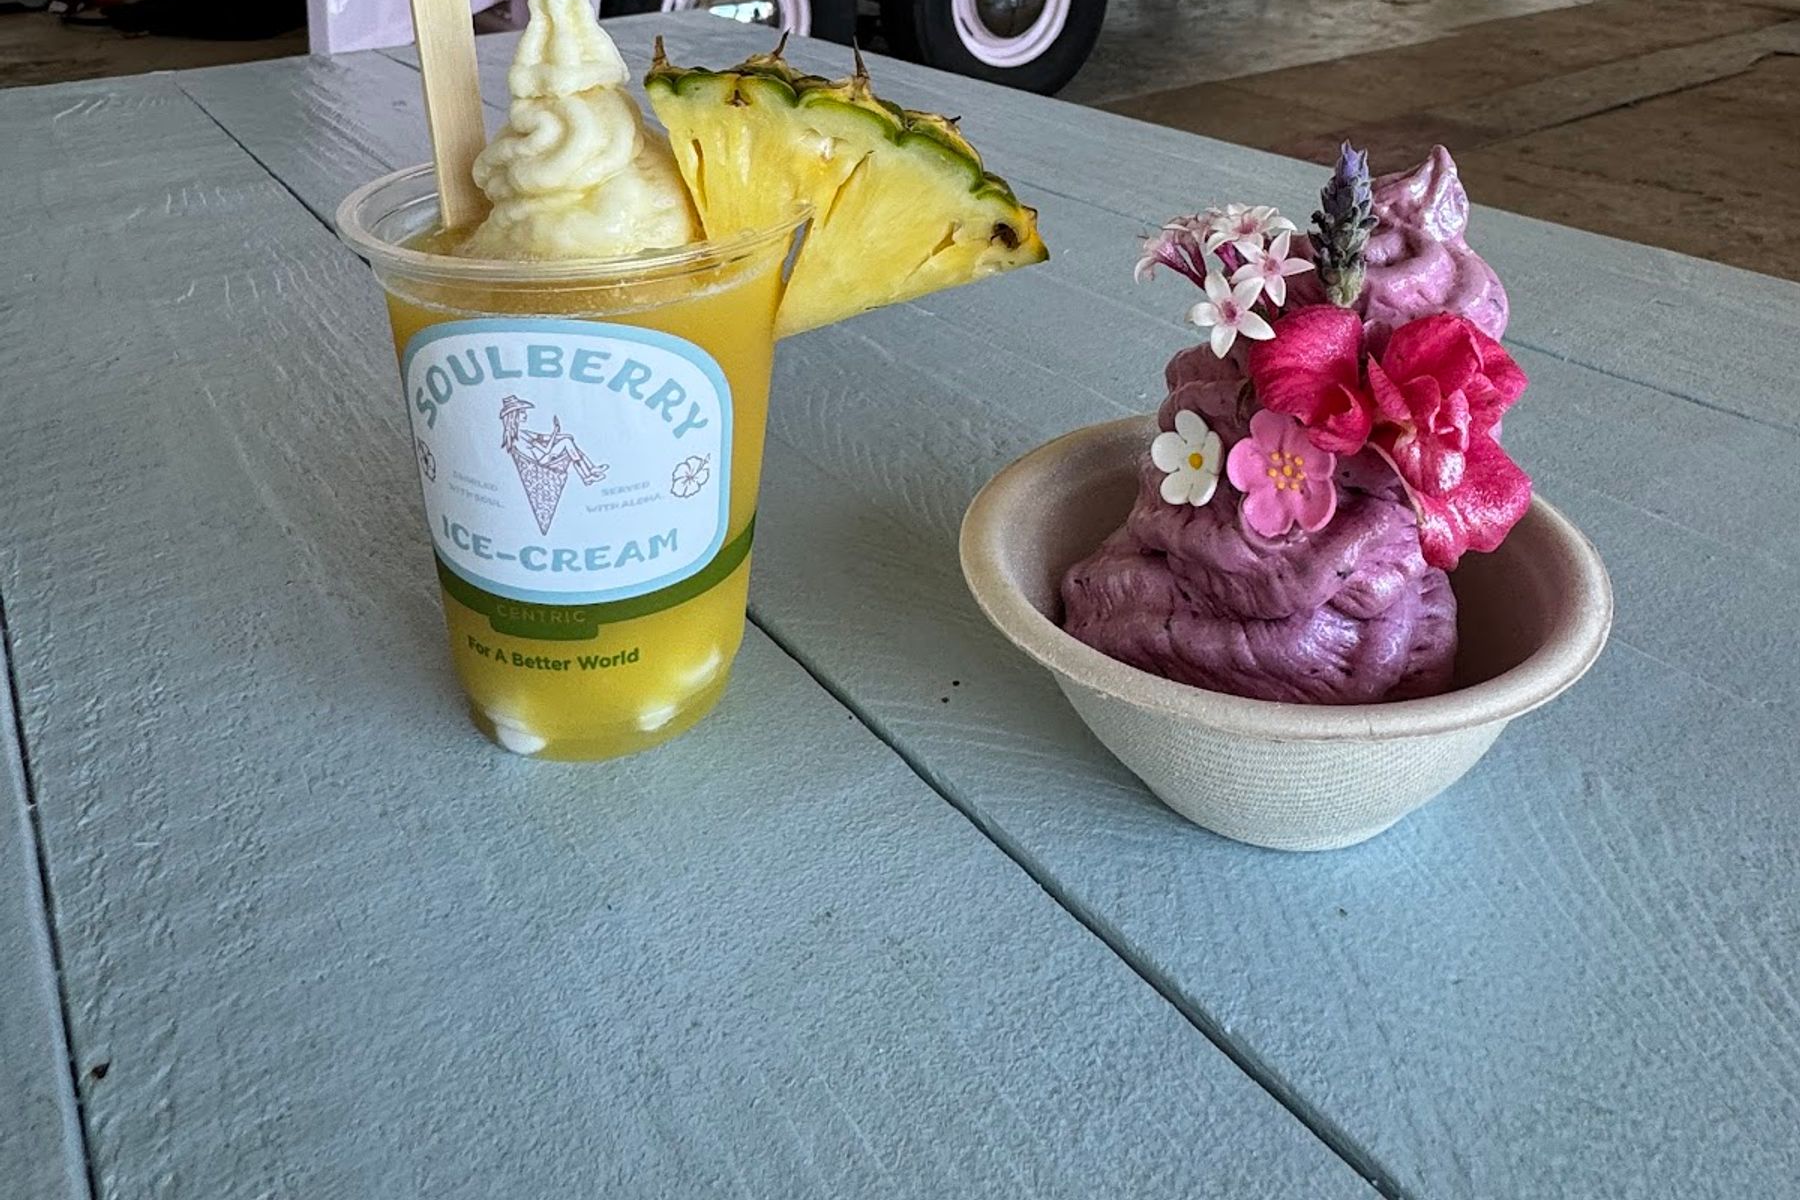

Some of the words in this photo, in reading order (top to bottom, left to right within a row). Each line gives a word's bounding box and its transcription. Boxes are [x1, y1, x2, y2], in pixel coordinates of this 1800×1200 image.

[414, 343, 709, 441] SOULBERRY
[586, 499, 620, 514] WITH
[621, 492, 663, 508] ALOHA
[601, 480, 650, 497] SERVED
[442, 514, 679, 573] ICE-CREAM
[496, 603, 587, 623] CENTRIC
[467, 635, 491, 657] For
[495, 648, 508, 664] A
[512, 652, 571, 671] Better
[577, 647, 640, 670] World
